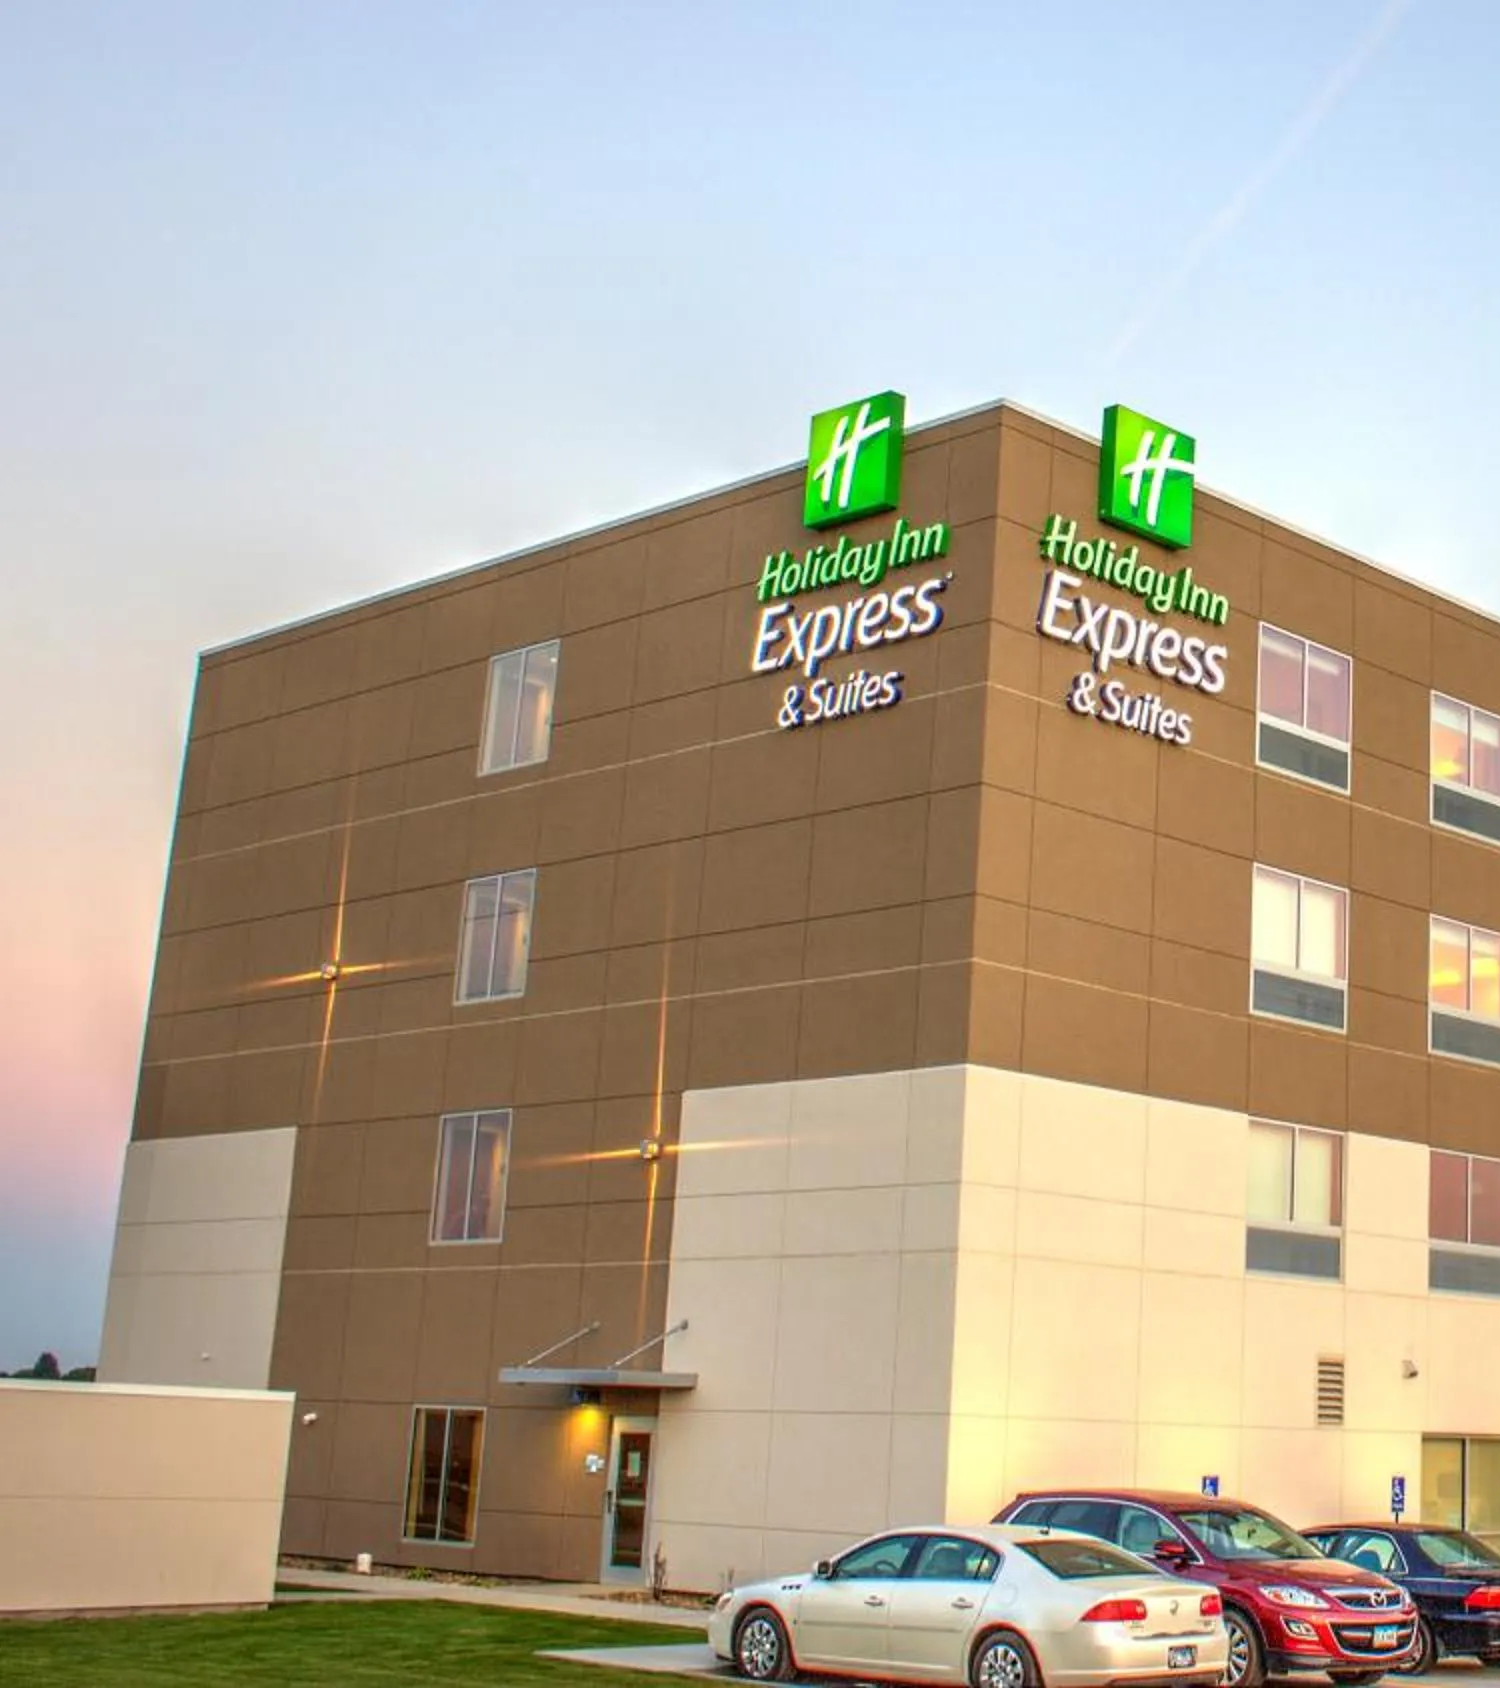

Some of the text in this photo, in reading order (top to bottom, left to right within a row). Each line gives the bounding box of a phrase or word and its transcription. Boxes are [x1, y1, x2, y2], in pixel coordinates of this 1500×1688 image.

[756, 518, 948, 601] Holiday Inn
[1044, 513, 1230, 625] Holiday Inn
[751, 578, 944, 678] Express
[1041, 568, 1228, 694] Express
[777, 669, 901, 728] & Suites
[1072, 671, 1193, 745] & Suites
